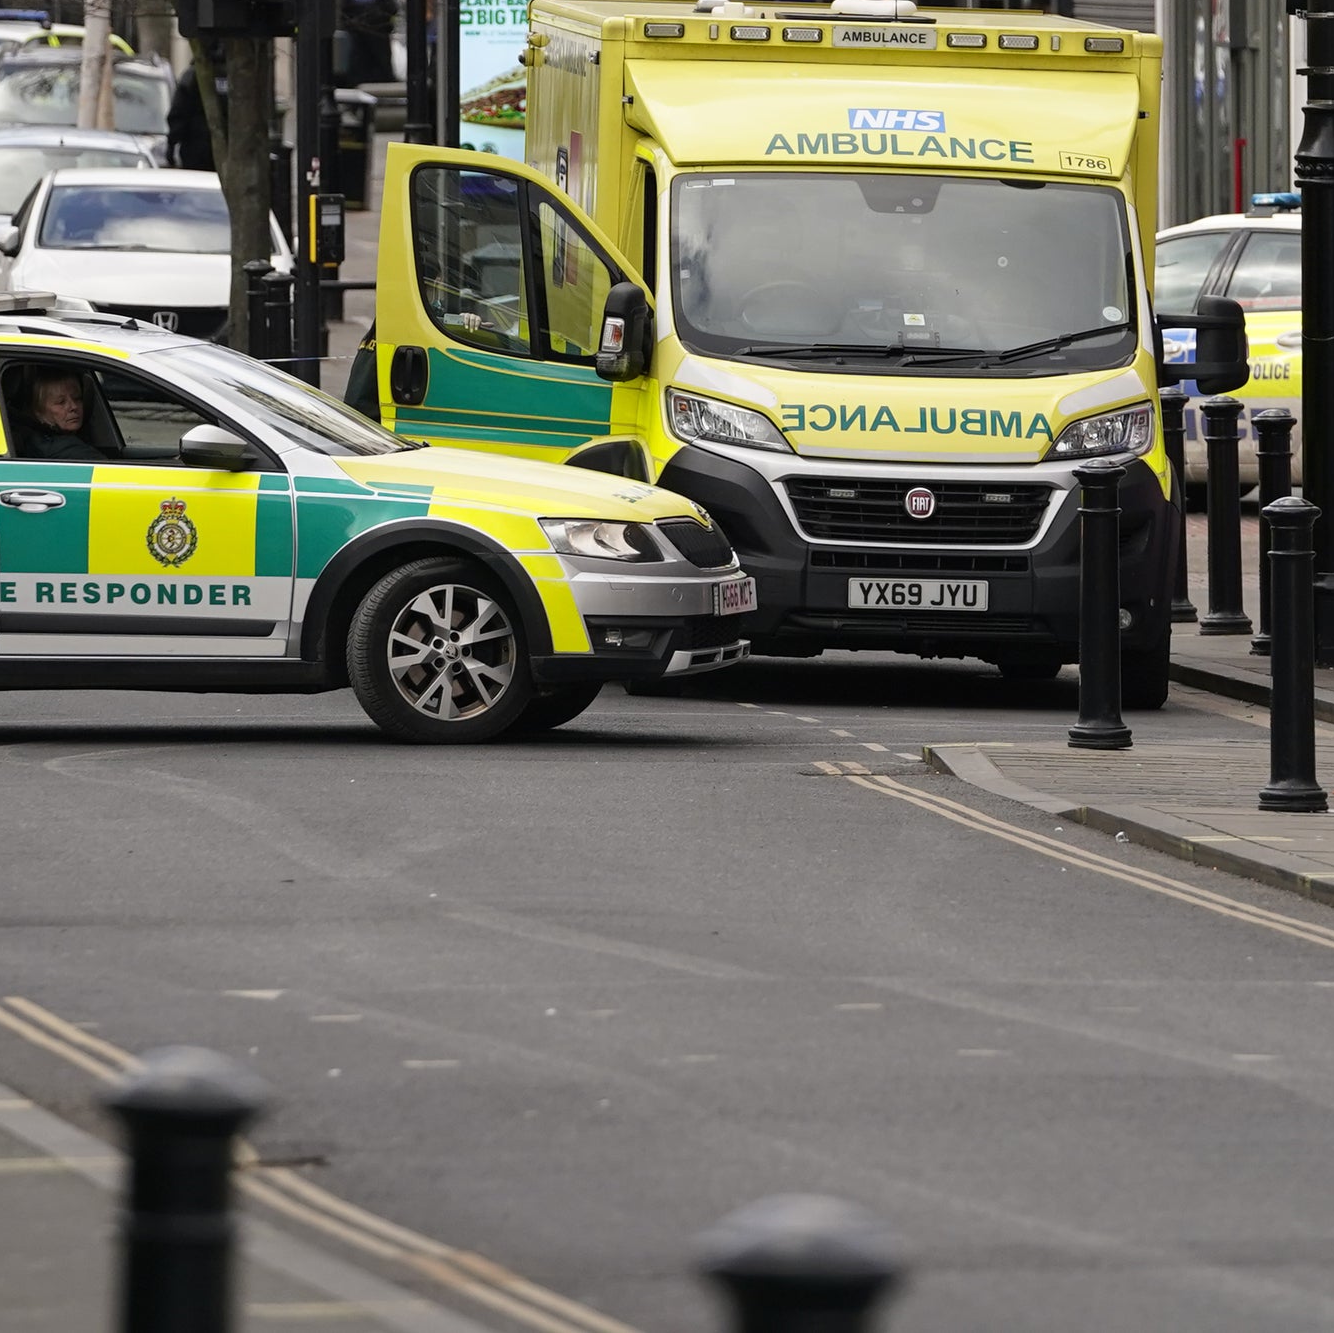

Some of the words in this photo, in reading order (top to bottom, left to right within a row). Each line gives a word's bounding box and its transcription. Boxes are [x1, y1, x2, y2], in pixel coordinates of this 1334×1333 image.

[477, 9, 506, 25] BIG
[841, 31, 928, 45] AMBULANCE
[852, 109, 942, 131] NHS
[764, 132, 1035, 164] AMBULANCE
[1064, 155, 1108, 171] 1786
[912, 496, 931, 511] FIAT
[36, 582, 253, 607] RESPONDER
[858, 582, 923, 606] YX69
[930, 584, 978, 607] JYU
